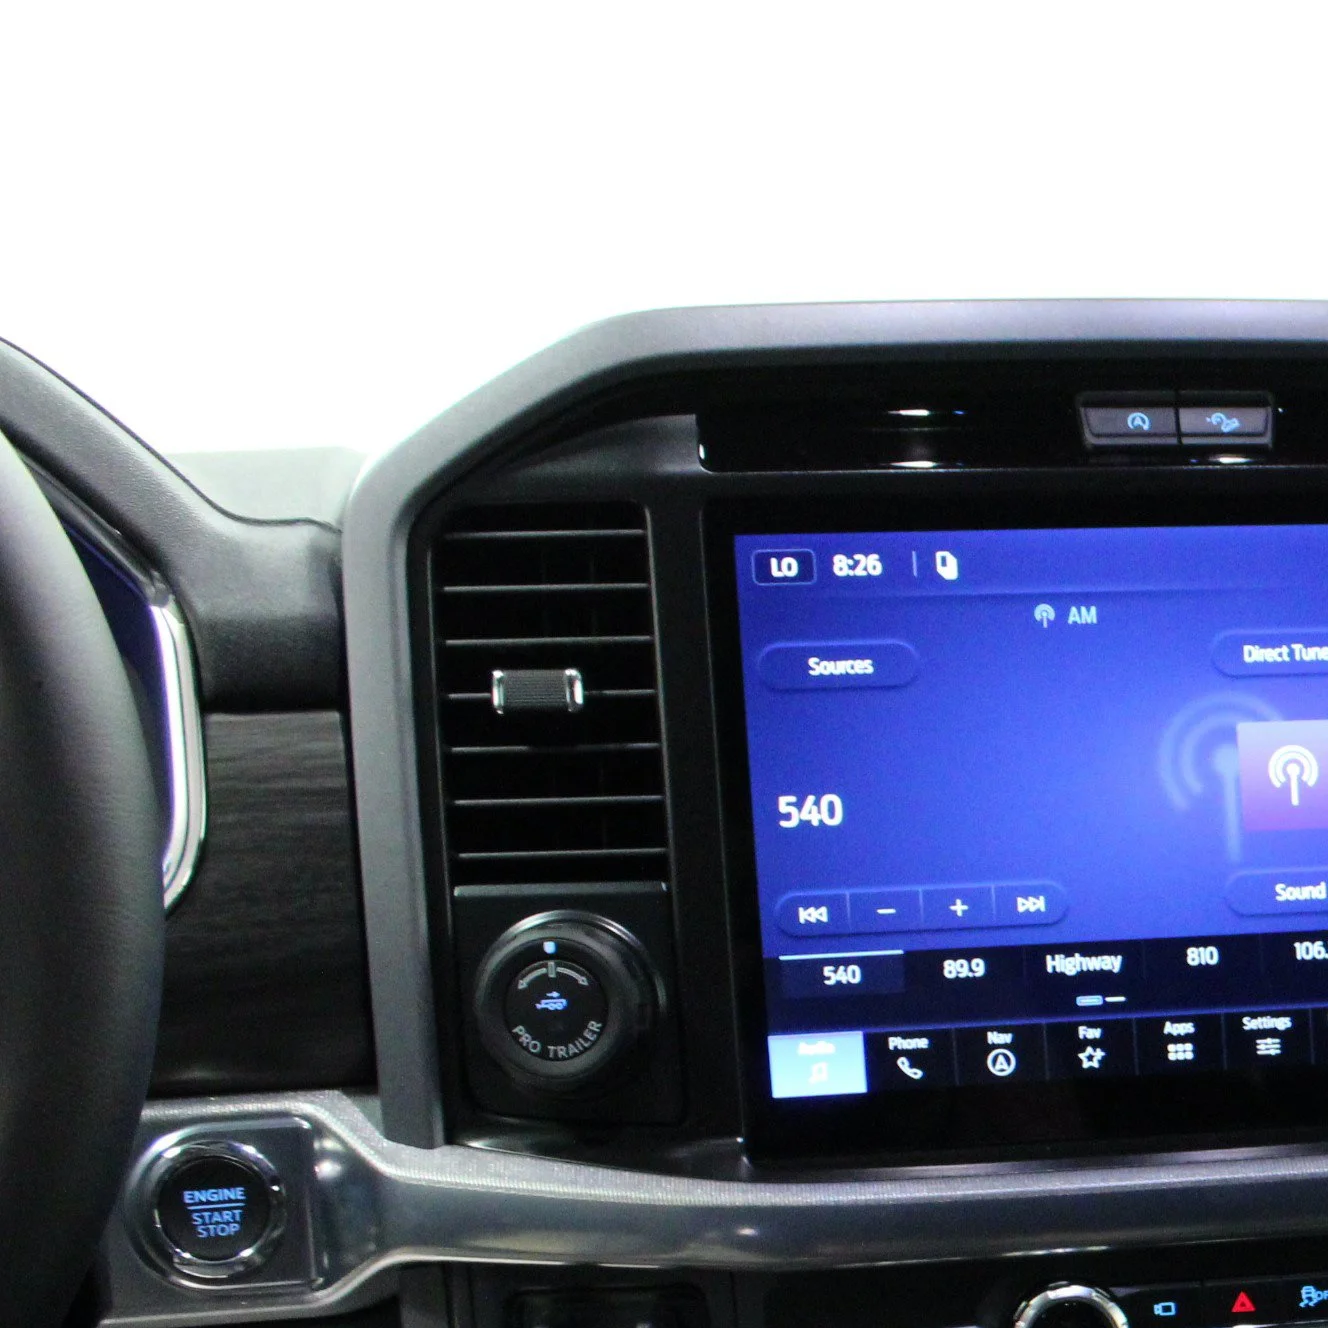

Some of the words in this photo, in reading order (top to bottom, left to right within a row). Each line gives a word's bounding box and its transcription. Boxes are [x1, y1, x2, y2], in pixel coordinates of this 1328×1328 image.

[769, 557, 799, 577] LO
[832, 554, 883, 577] 8:26
[1067, 606, 1098, 625] AM
[1242, 644, 1290, 663] Direct
[808, 657, 874, 676] Sources
[778, 794, 844, 828] 540
[1275, 882, 1327, 902] Sound
[1046, 953, 1122, 974] Highway
[1186, 946, 1219, 967] 810
[823, 965, 861, 986] 540
[943, 958, 986, 979] 89.9
[1078, 1025, 1102, 1041] Fav
[1163, 1020, 1195, 1037] Apps
[1242, 1015, 1293, 1032] Settings
[512, 1025, 542, 1053] PRO
[547, 1020, 603, 1059] TRAILER
[888, 1036, 929, 1052] Phone
[987, 1030, 1013, 1047] Nav
[183, 1187, 246, 1203] ENGINE
[192, 1210, 243, 1225] START
[197, 1224, 240, 1238] STOP
